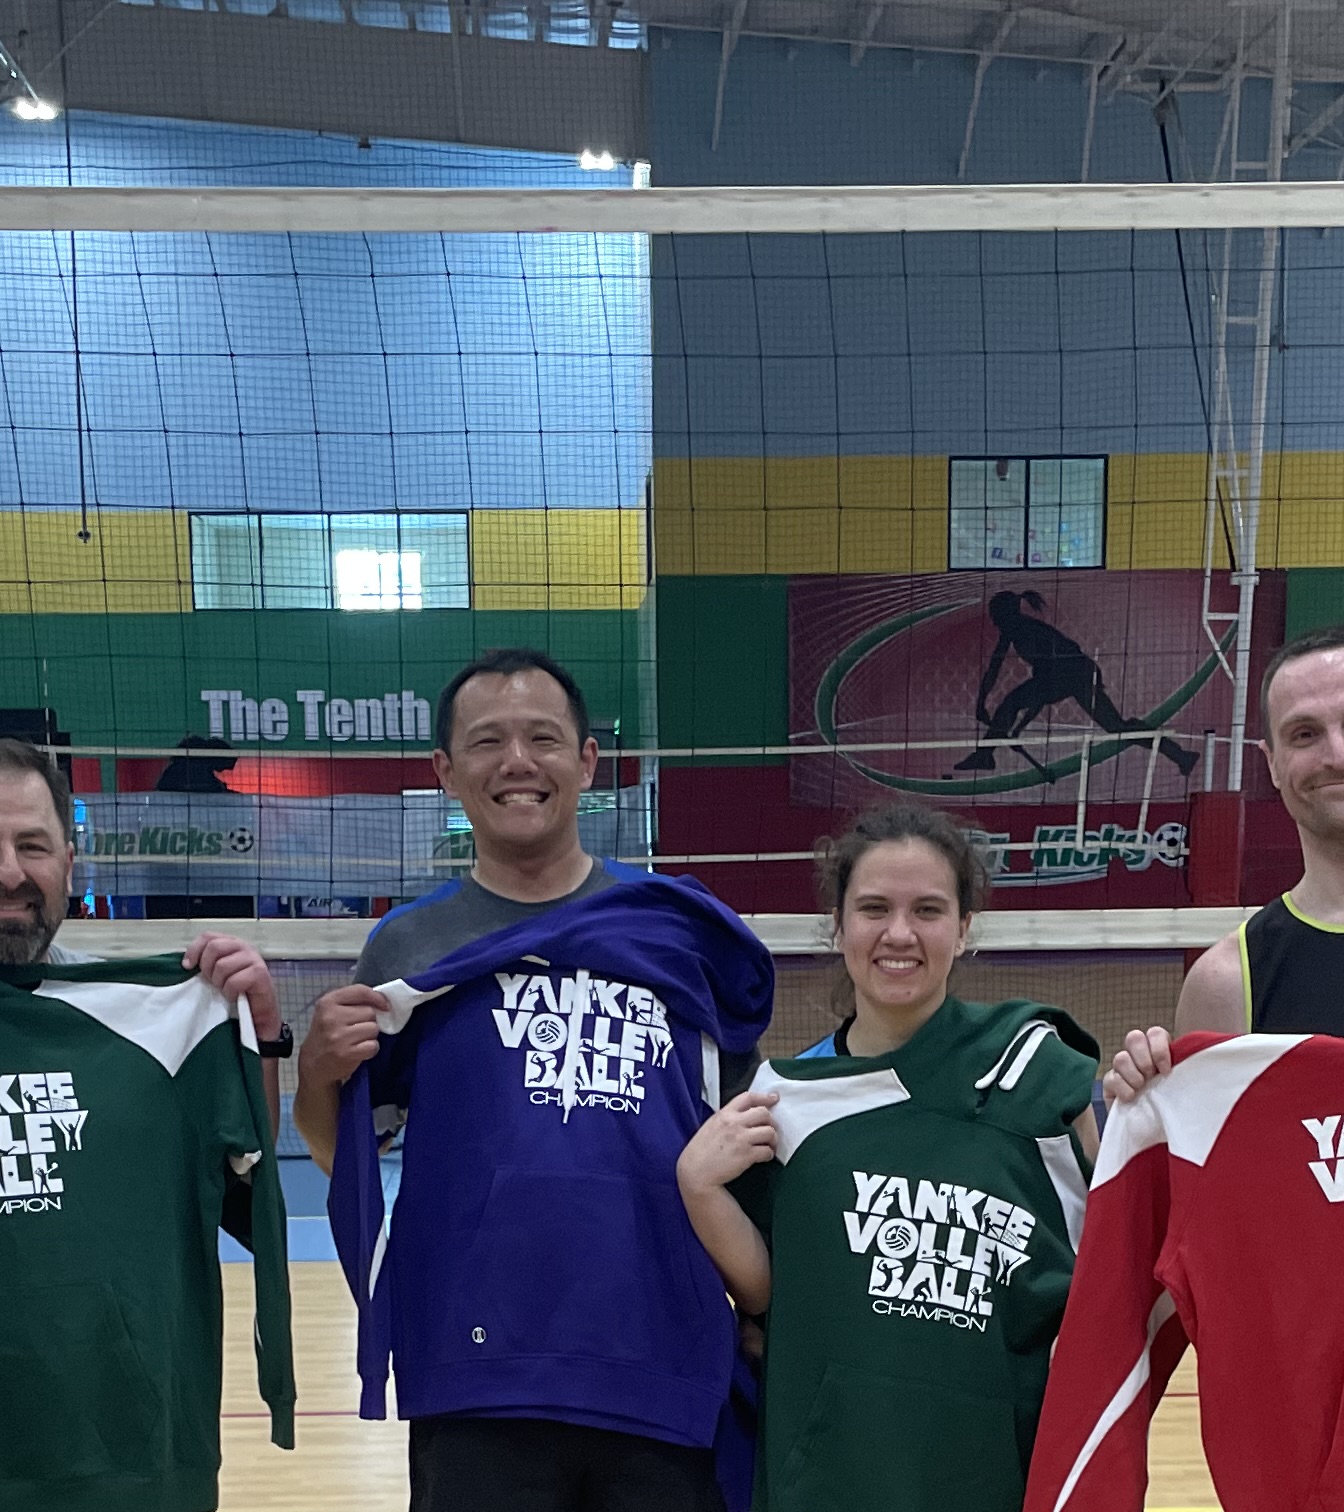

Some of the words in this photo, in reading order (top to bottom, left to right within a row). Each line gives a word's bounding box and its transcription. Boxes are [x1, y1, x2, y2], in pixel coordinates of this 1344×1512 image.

[200, 689, 289, 741] The
[296, 689, 432, 742] Tenth
[138, 826, 224, 857] Kicks
[524, 1050, 645, 1100] BALL
[852, 1170, 1036, 1252] YANKEE
[843, 1210, 1032, 1287] VOLLEY
[867, 1255, 994, 1317] BALL
[872, 1299, 987, 1333] CHAMPION
